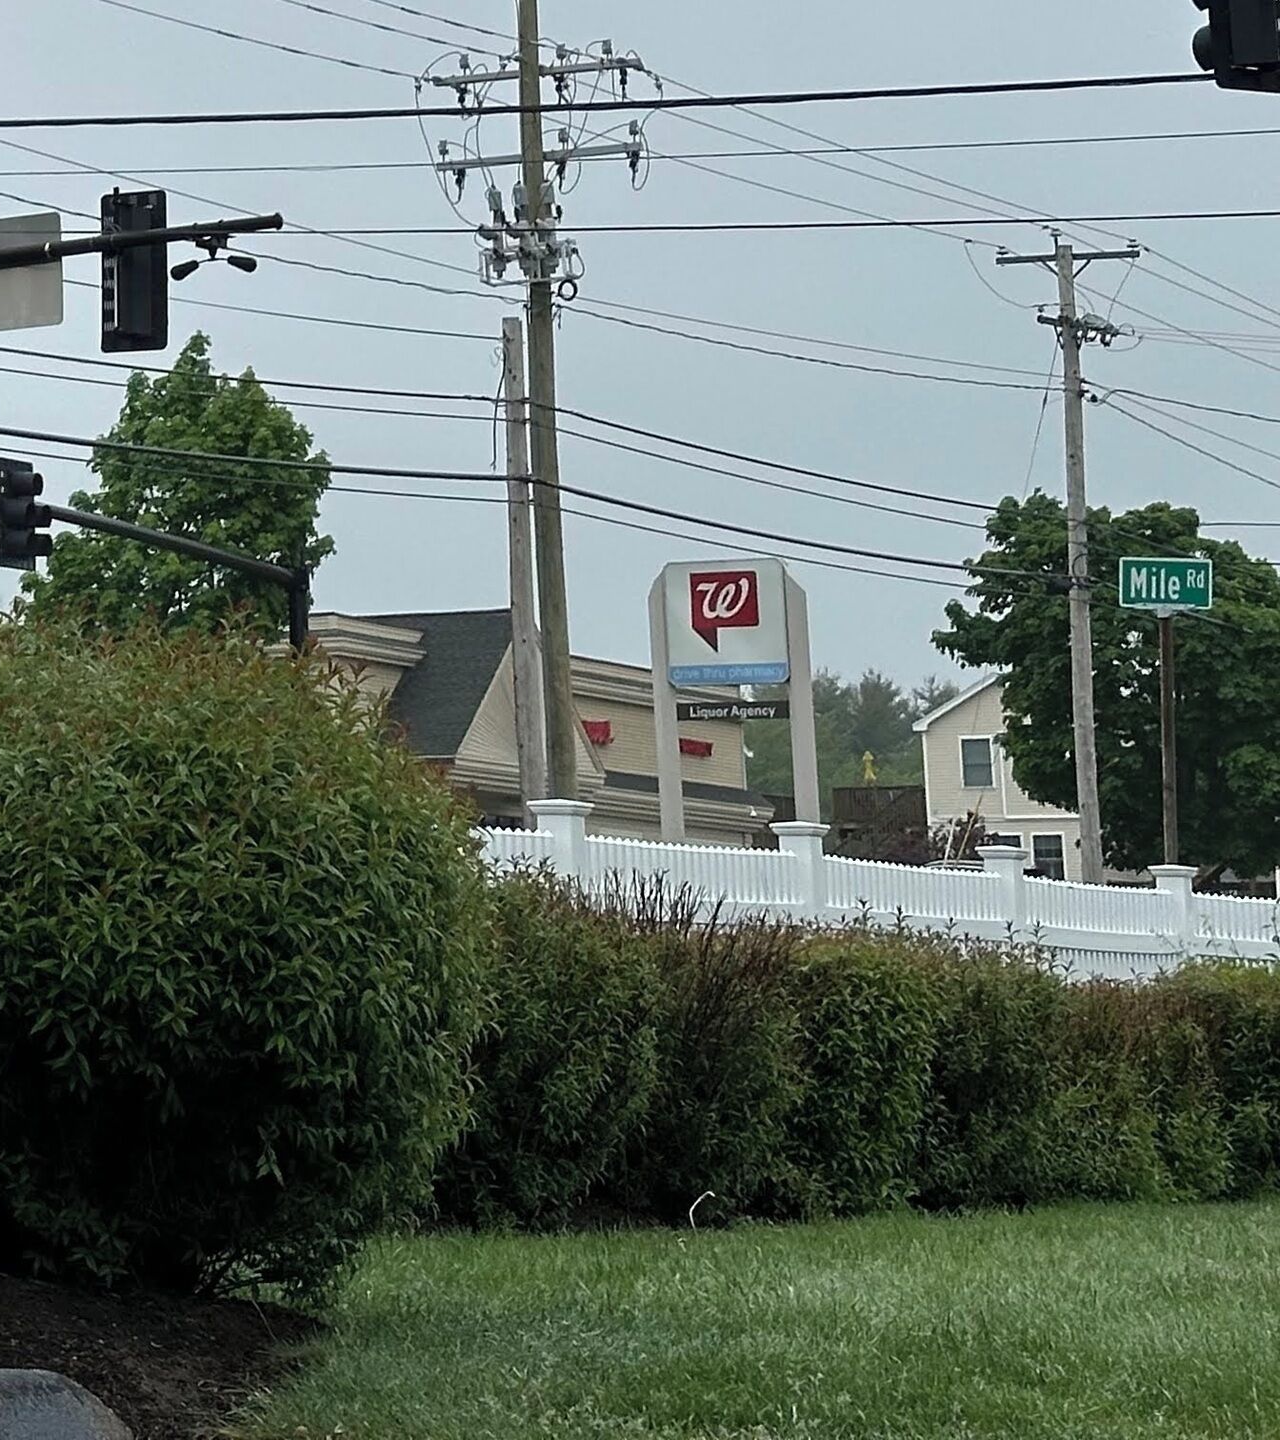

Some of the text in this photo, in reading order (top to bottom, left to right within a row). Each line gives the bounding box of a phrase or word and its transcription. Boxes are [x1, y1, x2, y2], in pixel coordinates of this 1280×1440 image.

[696, 577, 750, 619] W
[1130, 566, 1205, 600] Mile Rd
[689, 705, 777, 720] Liquor Agency
